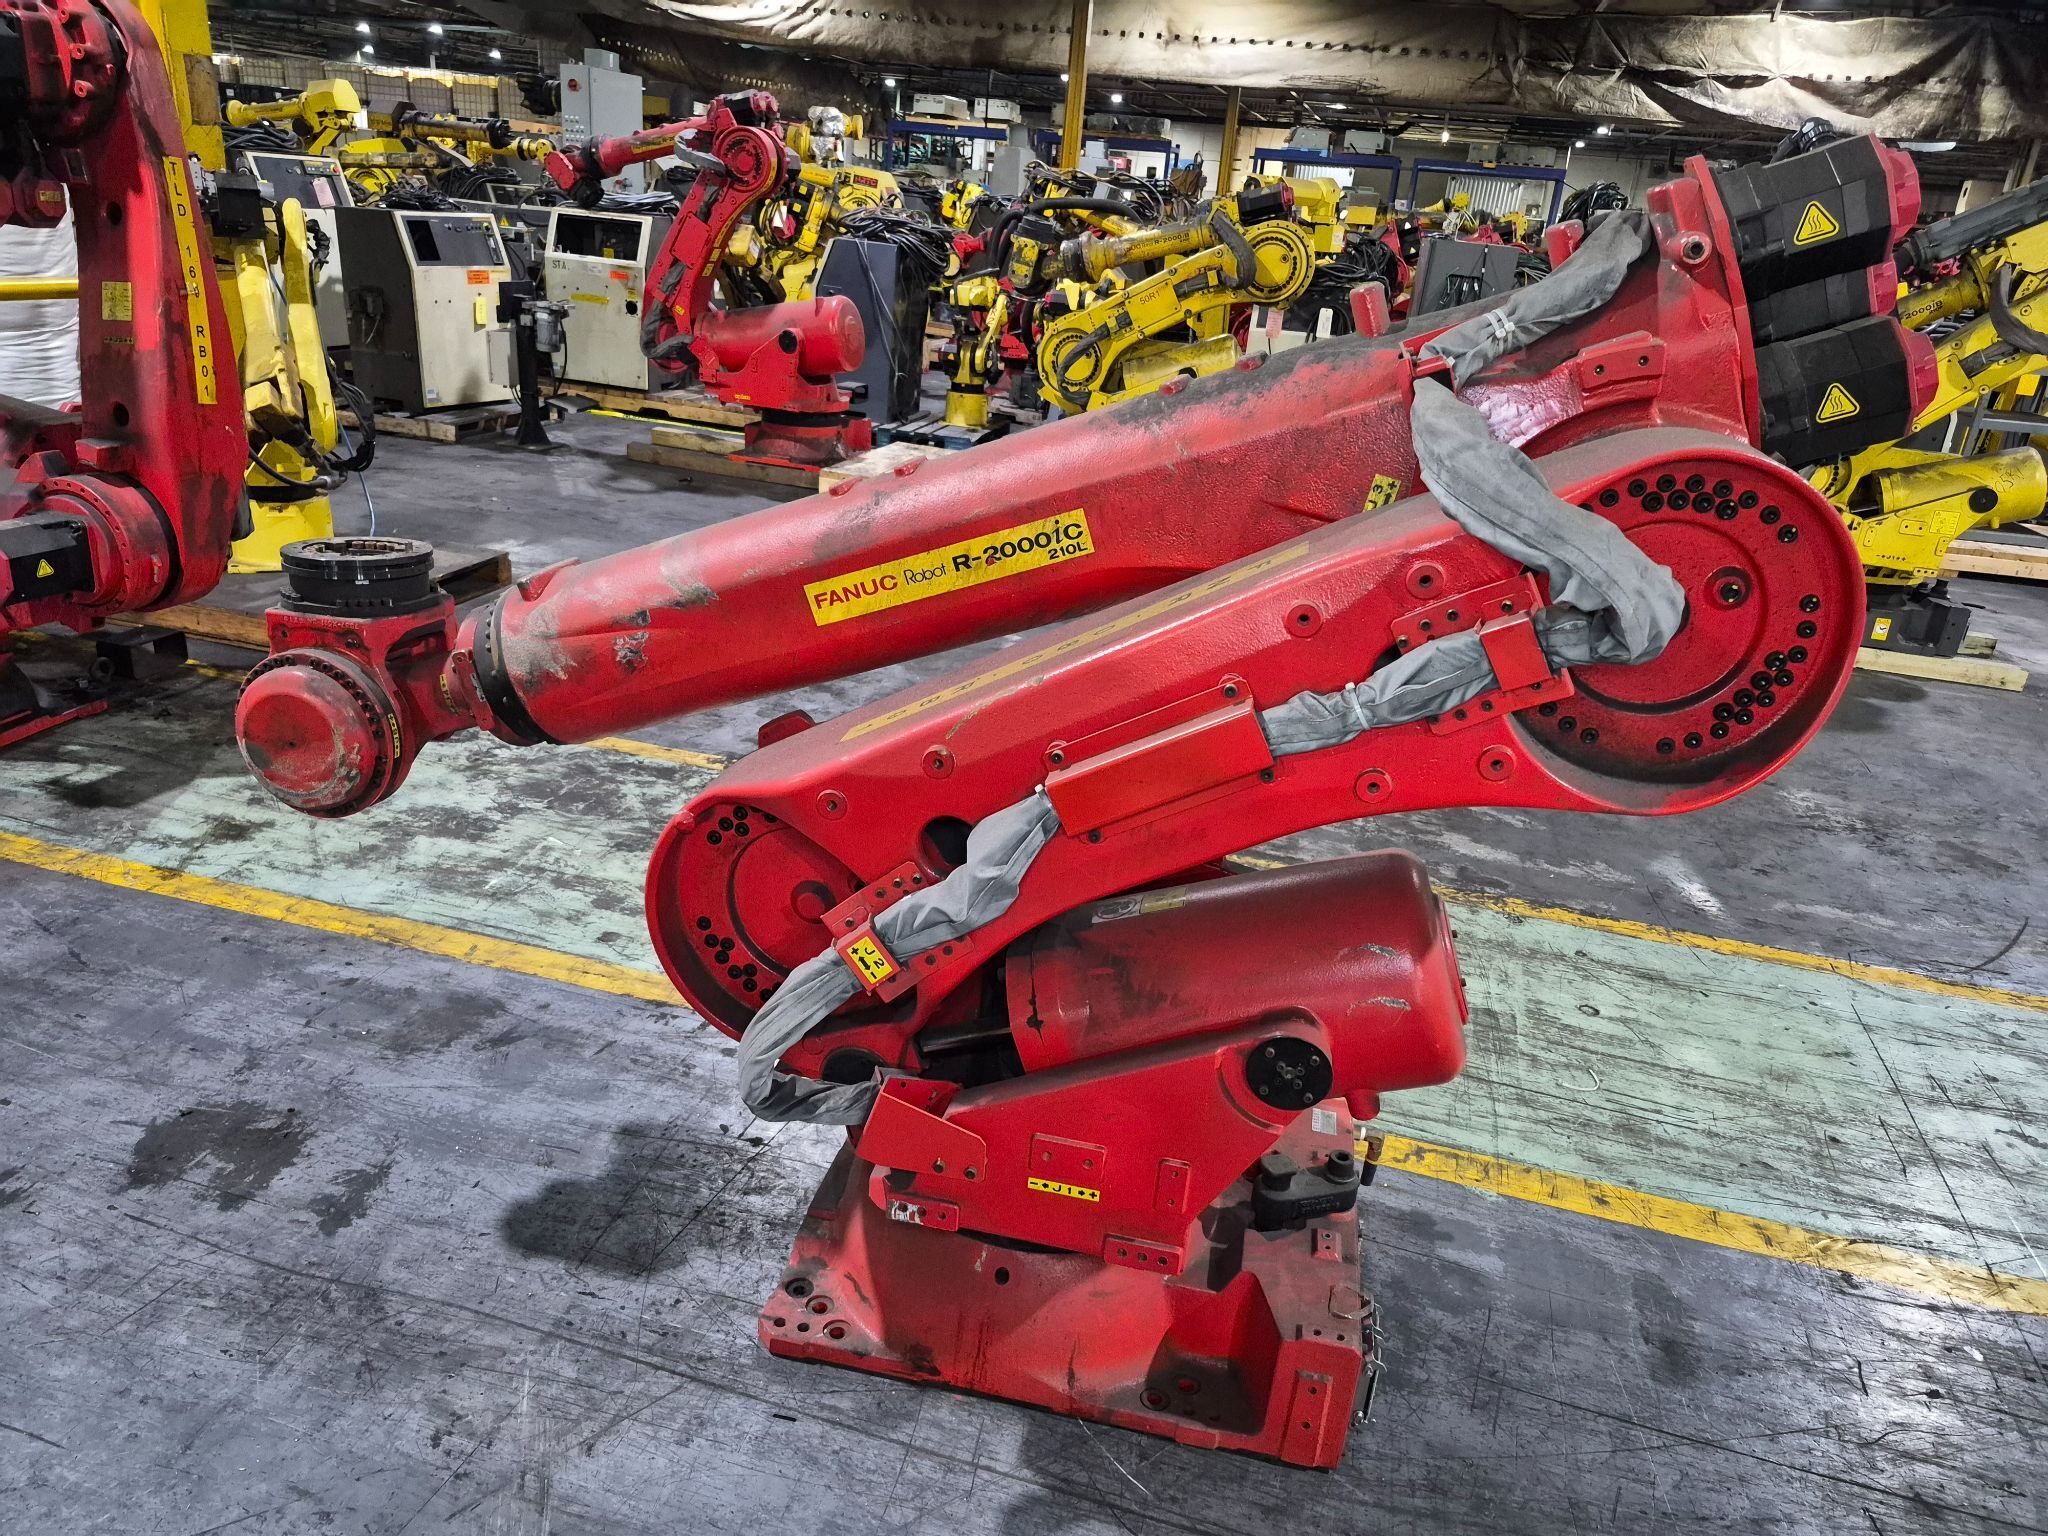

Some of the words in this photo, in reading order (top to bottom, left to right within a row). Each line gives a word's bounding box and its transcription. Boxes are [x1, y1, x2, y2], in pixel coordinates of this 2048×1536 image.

[168, 161, 187, 217] TLD
[195, 325, 210, 397] RB01
[1047, 541, 1088, 560] 210L
[813, 574, 898, 609] FANUC
[903, 563, 947, 585] Robot
[952, 520, 1083, 573] R-2000iC
[864, 947, 885, 969] J2
[1052, 1185, 1072, 1195] J1
